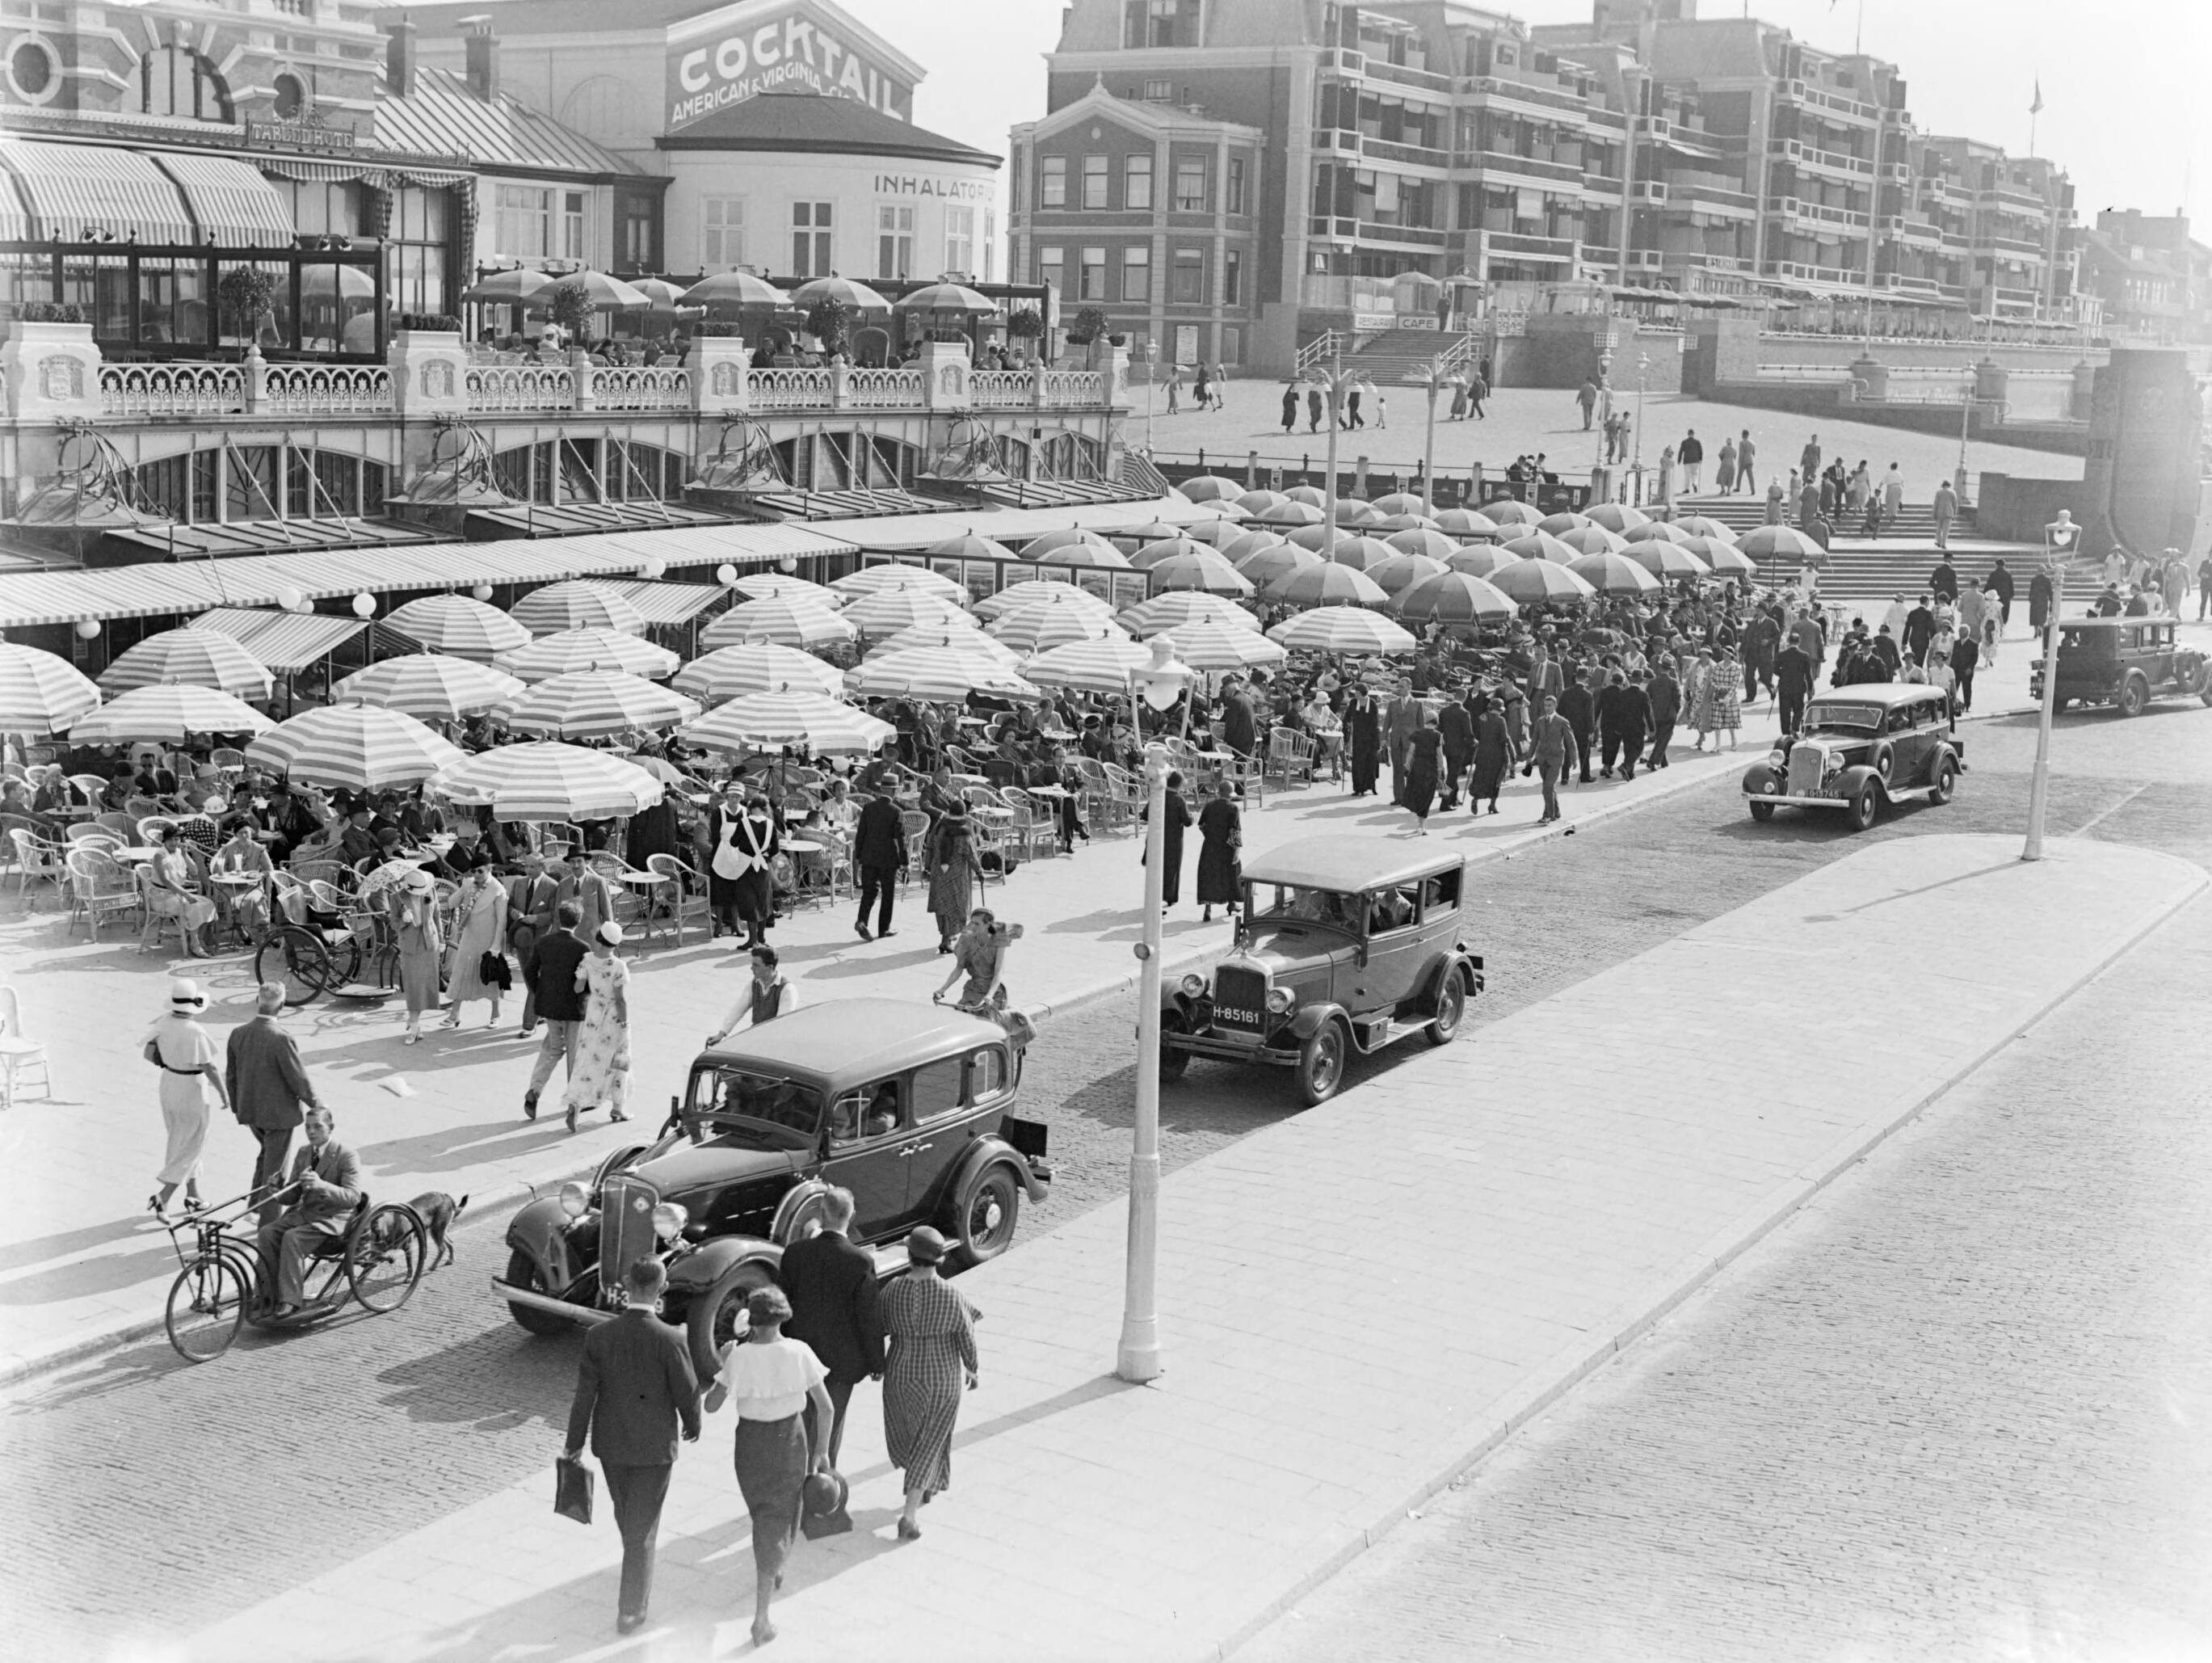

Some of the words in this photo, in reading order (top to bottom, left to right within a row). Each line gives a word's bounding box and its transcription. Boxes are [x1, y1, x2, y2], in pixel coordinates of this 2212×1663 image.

[679, 16, 902, 122] COCKTAIL
[671, 78, 749, 124] AMERICAN
[751, 78, 761, 93] &
[762, 61, 822, 95] VIRGINIA
[1402, 318, 1436, 329] CAFE
[1213, 1005, 1259, 1025] H-85161
